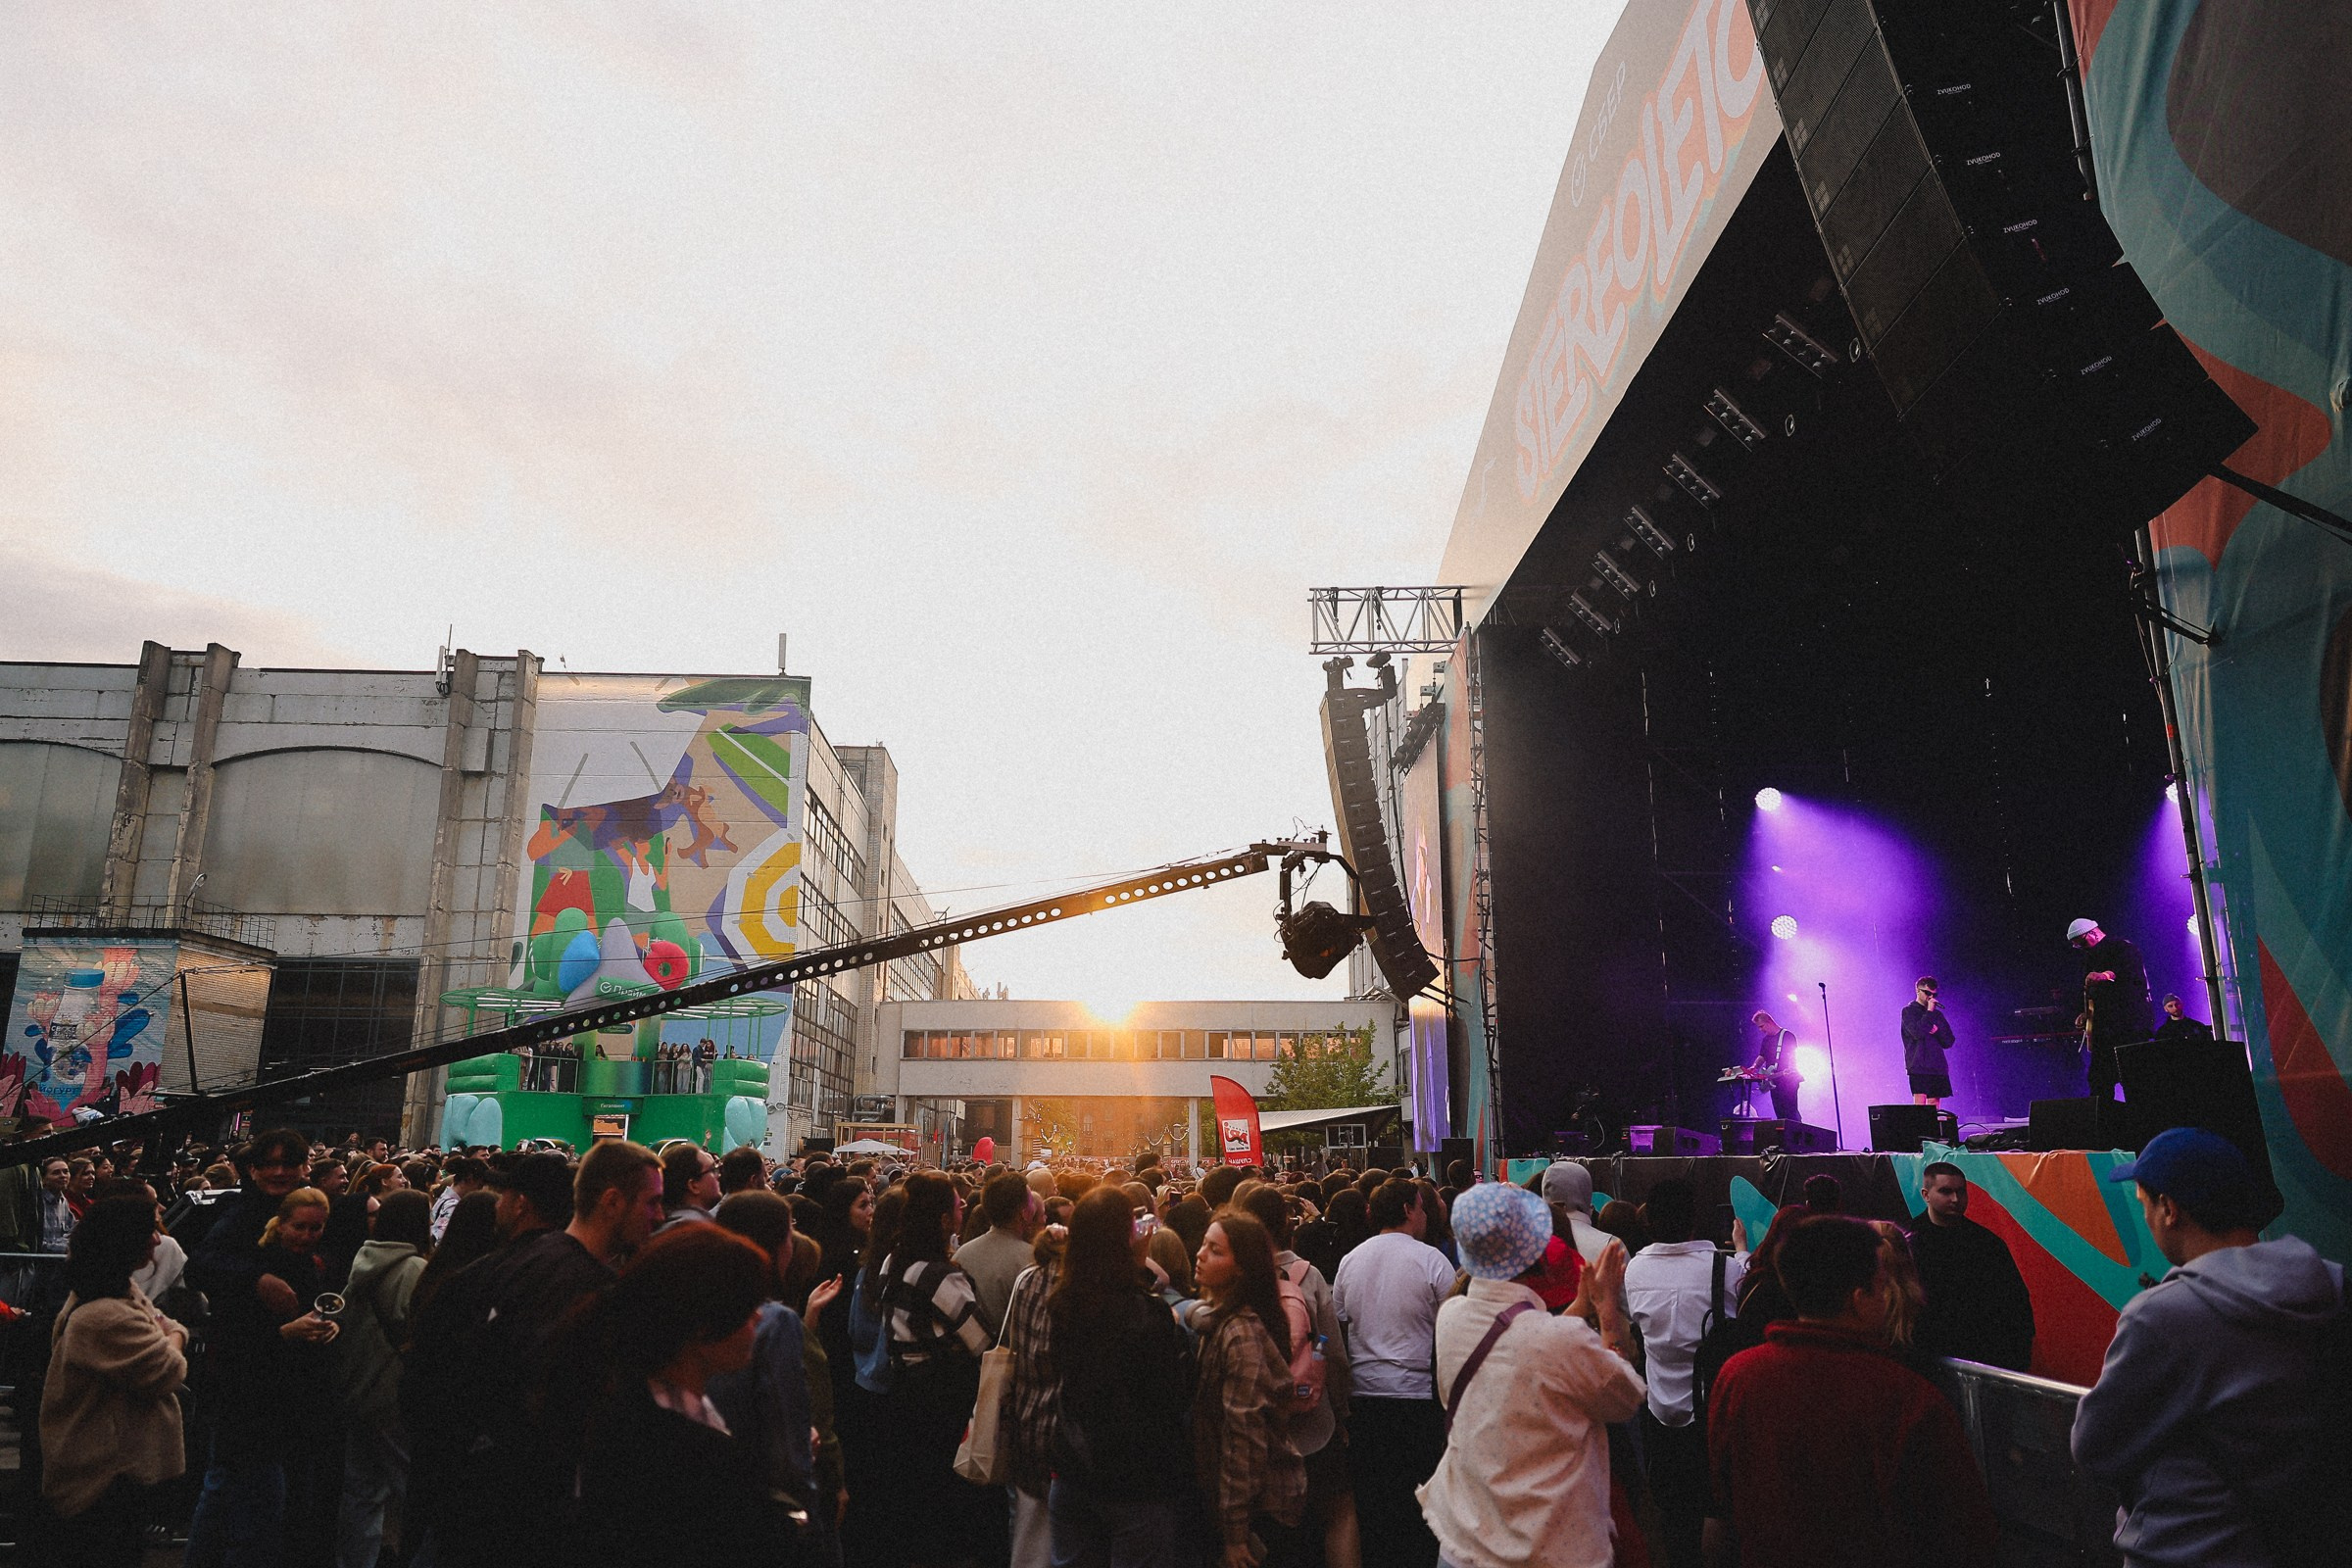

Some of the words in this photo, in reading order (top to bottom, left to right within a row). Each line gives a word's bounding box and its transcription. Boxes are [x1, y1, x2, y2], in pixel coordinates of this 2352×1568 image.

[1936, 83, 1972, 95] ZVUKOHOD
[1589, 60, 1626, 162] СБЕР
[1966, 152, 2001, 166] ZVUKOHOD
[2003, 219, 2038, 234] ZVUKOHOD
[2036, 287, 2070, 305] ZVUKOHOD
[2081, 356, 2112, 374] ZVUKOHOD
[2132, 418, 2162, 441] ZVUKOHOD
[612, 985, 647, 998] Прайм
